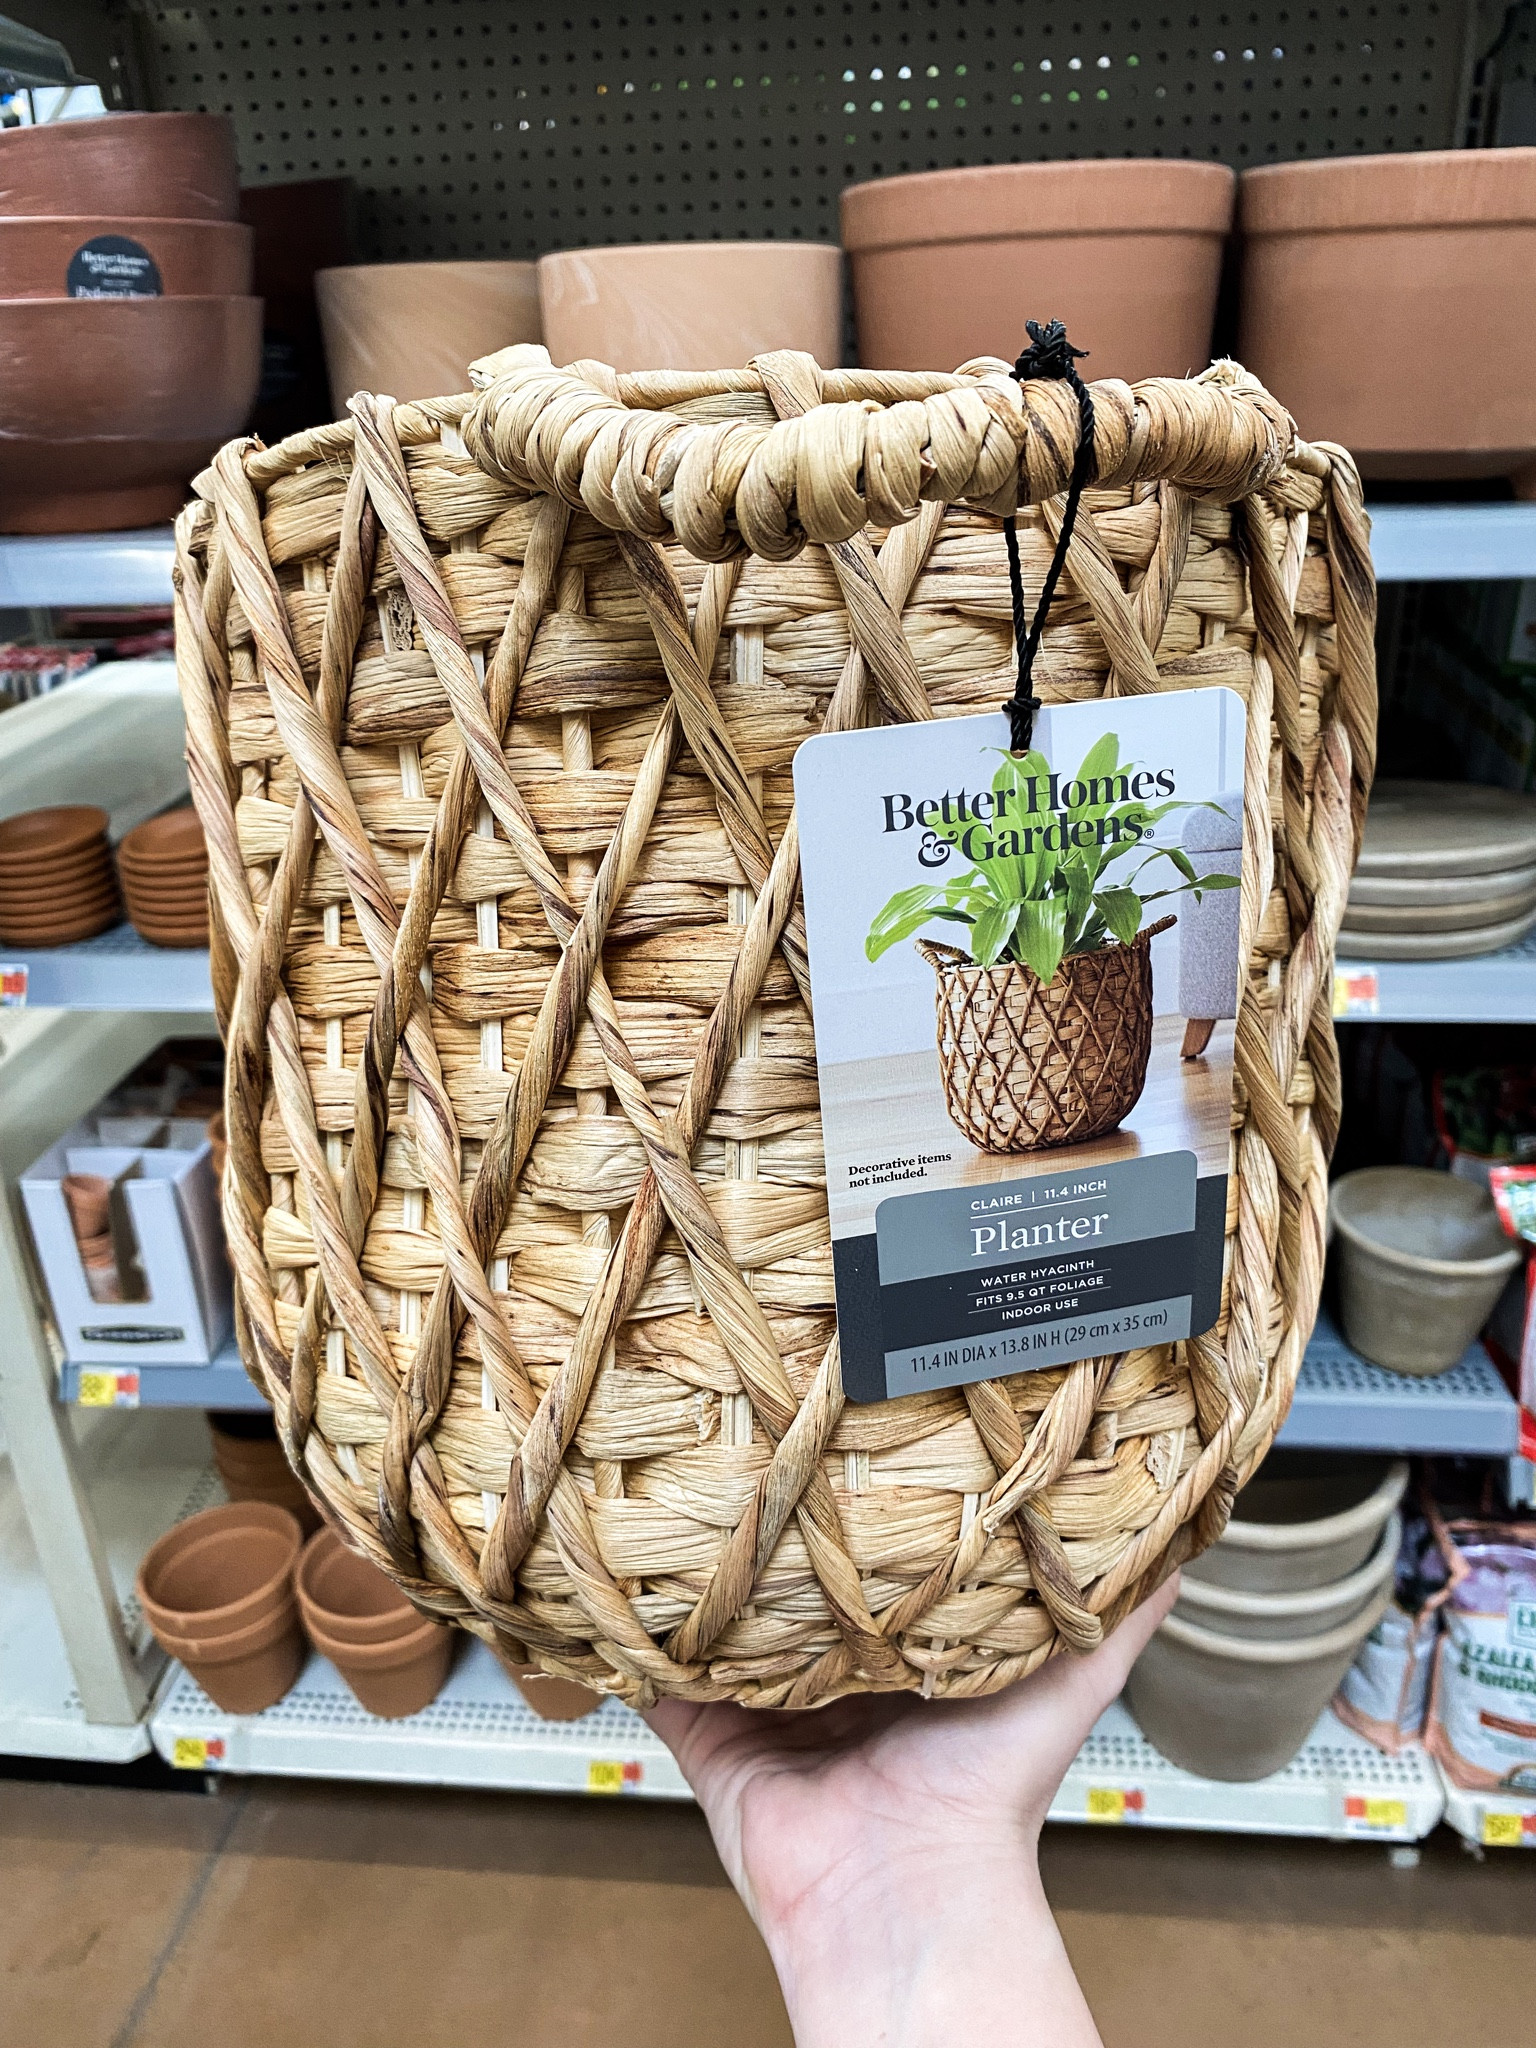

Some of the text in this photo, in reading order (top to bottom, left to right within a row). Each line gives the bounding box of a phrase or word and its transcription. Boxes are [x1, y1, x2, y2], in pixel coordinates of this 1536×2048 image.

[880, 768, 1176, 833] Better Homes
[848, 1152, 952, 1176] Decorative items
[849, 1167, 928, 1188] not included.
[970, 1179, 1107, 1211] CLAIRE 11.4 INCH
[970, 1212, 1109, 1257] Planter
[980, 1260, 1095, 1288] WATER HYACINTH
[975, 1276, 1104, 1308] FITS 9.5 QT FOLIAGE
[1001, 1298, 1079, 1321] INDOOR USE
[910, 1309, 1168, 1373] 11.4 IN DIA x 13.8 IN H (29 cm x 35 cm)
